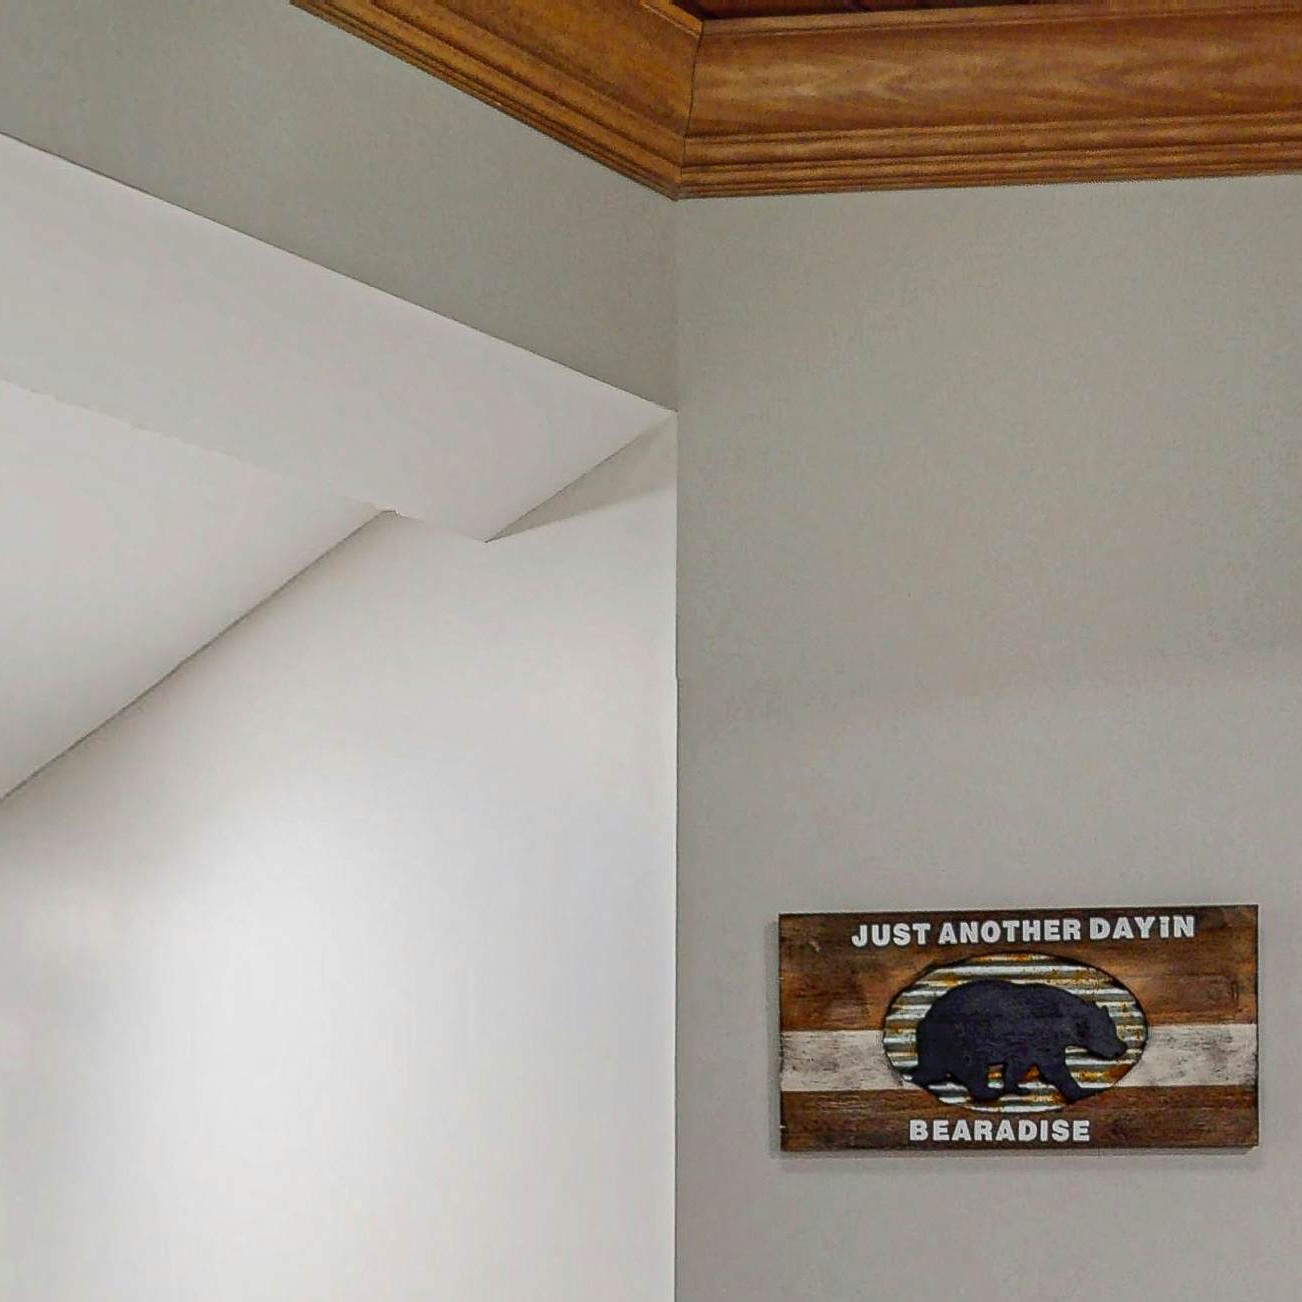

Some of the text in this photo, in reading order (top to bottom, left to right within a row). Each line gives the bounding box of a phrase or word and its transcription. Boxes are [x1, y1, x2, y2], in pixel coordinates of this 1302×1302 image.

[851, 922, 931, 947] JUST
[938, 918, 1082, 944] ANOTHER
[909, 1119, 1090, 1142] BEARADISE
